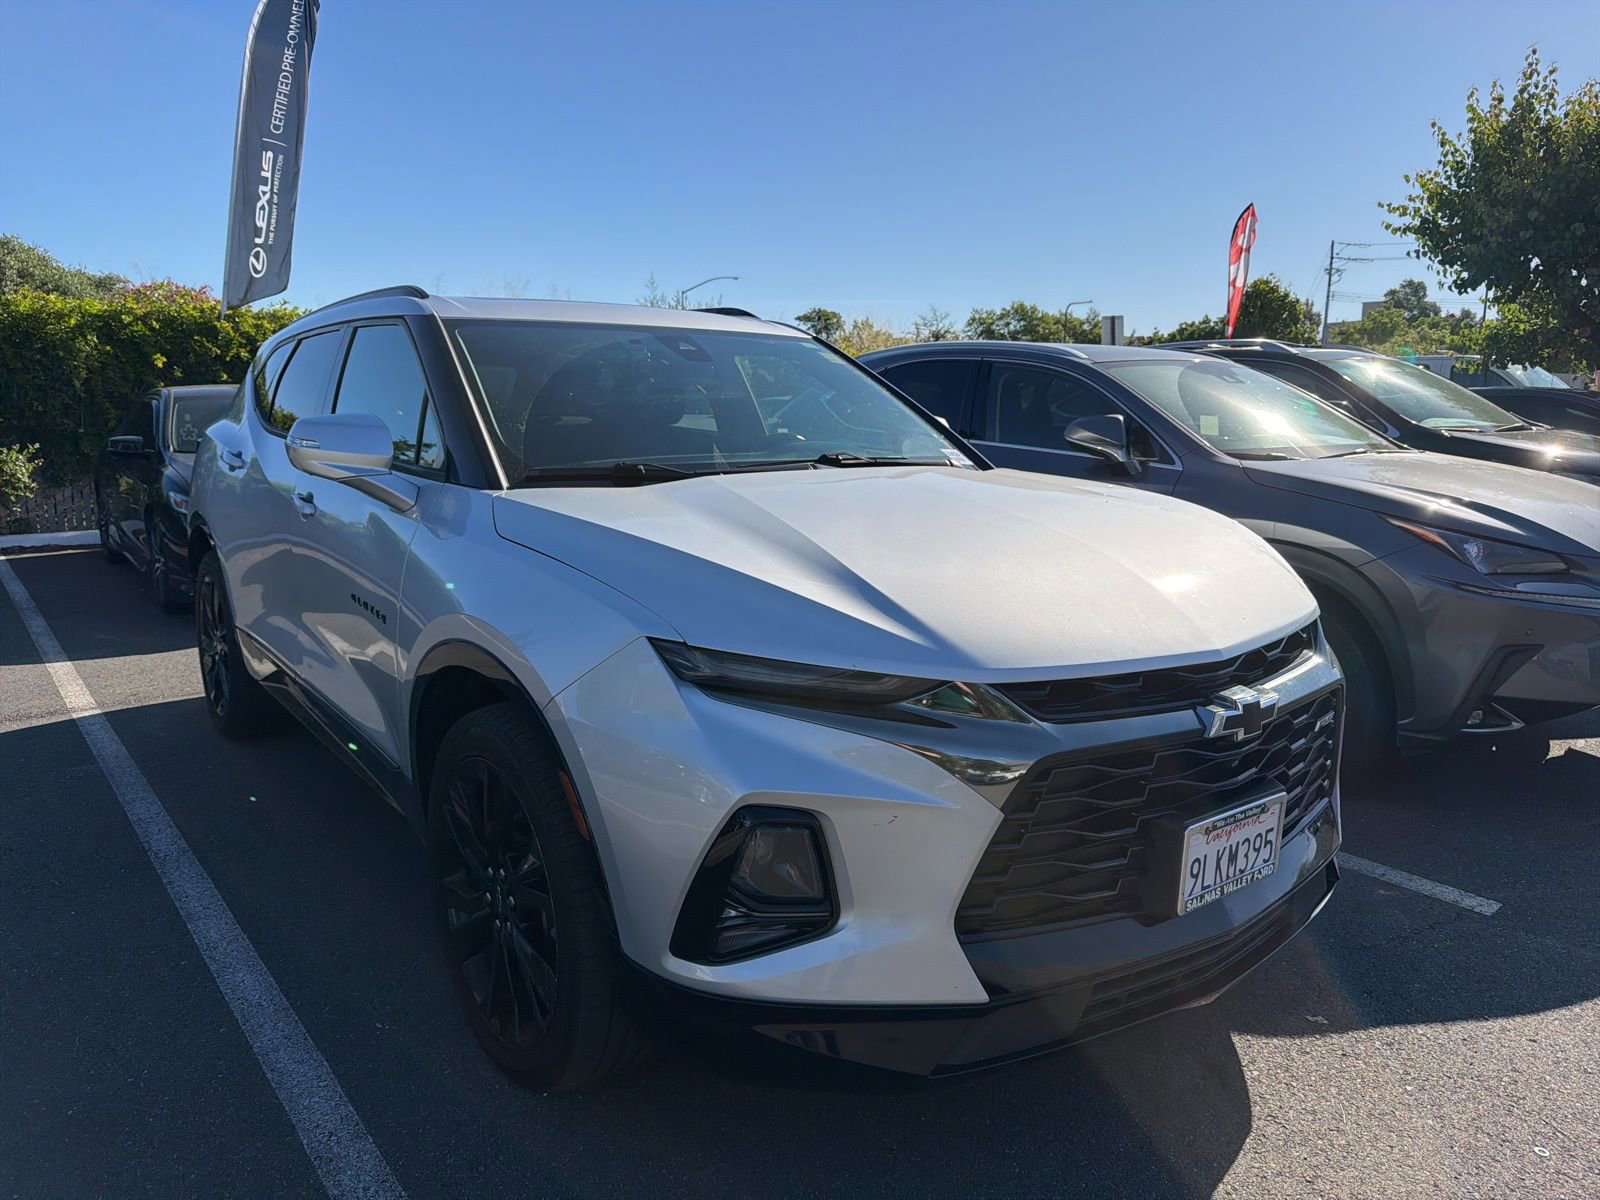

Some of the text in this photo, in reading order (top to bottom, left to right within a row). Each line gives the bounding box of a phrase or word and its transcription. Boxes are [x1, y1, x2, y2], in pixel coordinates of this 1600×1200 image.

[270, 72, 292, 134] CERTIFIED
[254, 150, 274, 244] LEXUS
[268, 154, 284, 245] THE PURSUIT OF PERFECTION
[1206, 815, 1265, 844] California
[1235, 812, 1246, 822] The
[1185, 864, 1274, 912] SALINAS VALLEY FORD
[1188, 827, 1275, 898] 9LKM395
